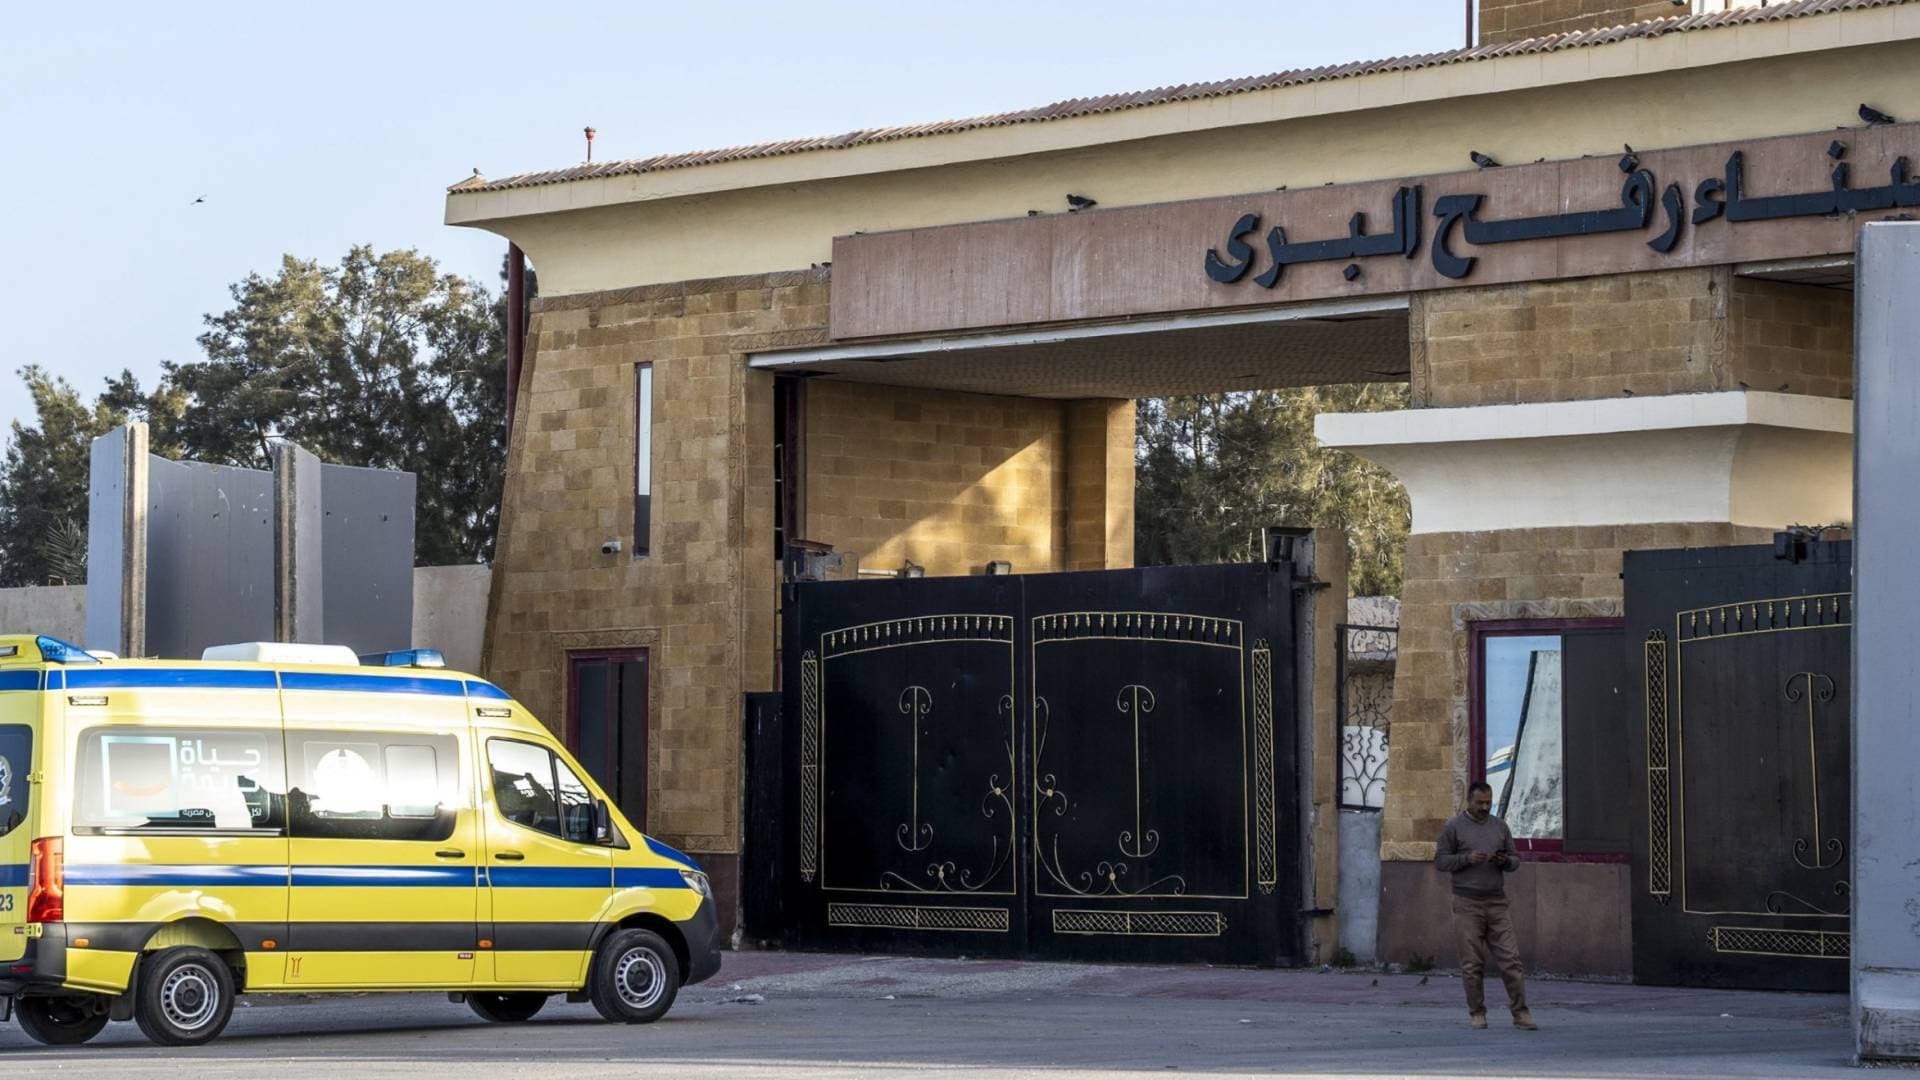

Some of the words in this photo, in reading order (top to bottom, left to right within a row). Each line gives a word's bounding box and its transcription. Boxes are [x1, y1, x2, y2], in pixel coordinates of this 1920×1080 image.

[1692, 139, 1920, 224] يناء
[1431, 152, 1684, 280] رفح
[180, 739, 261, 773] حياة
[180, 766, 261, 798] كيمة
